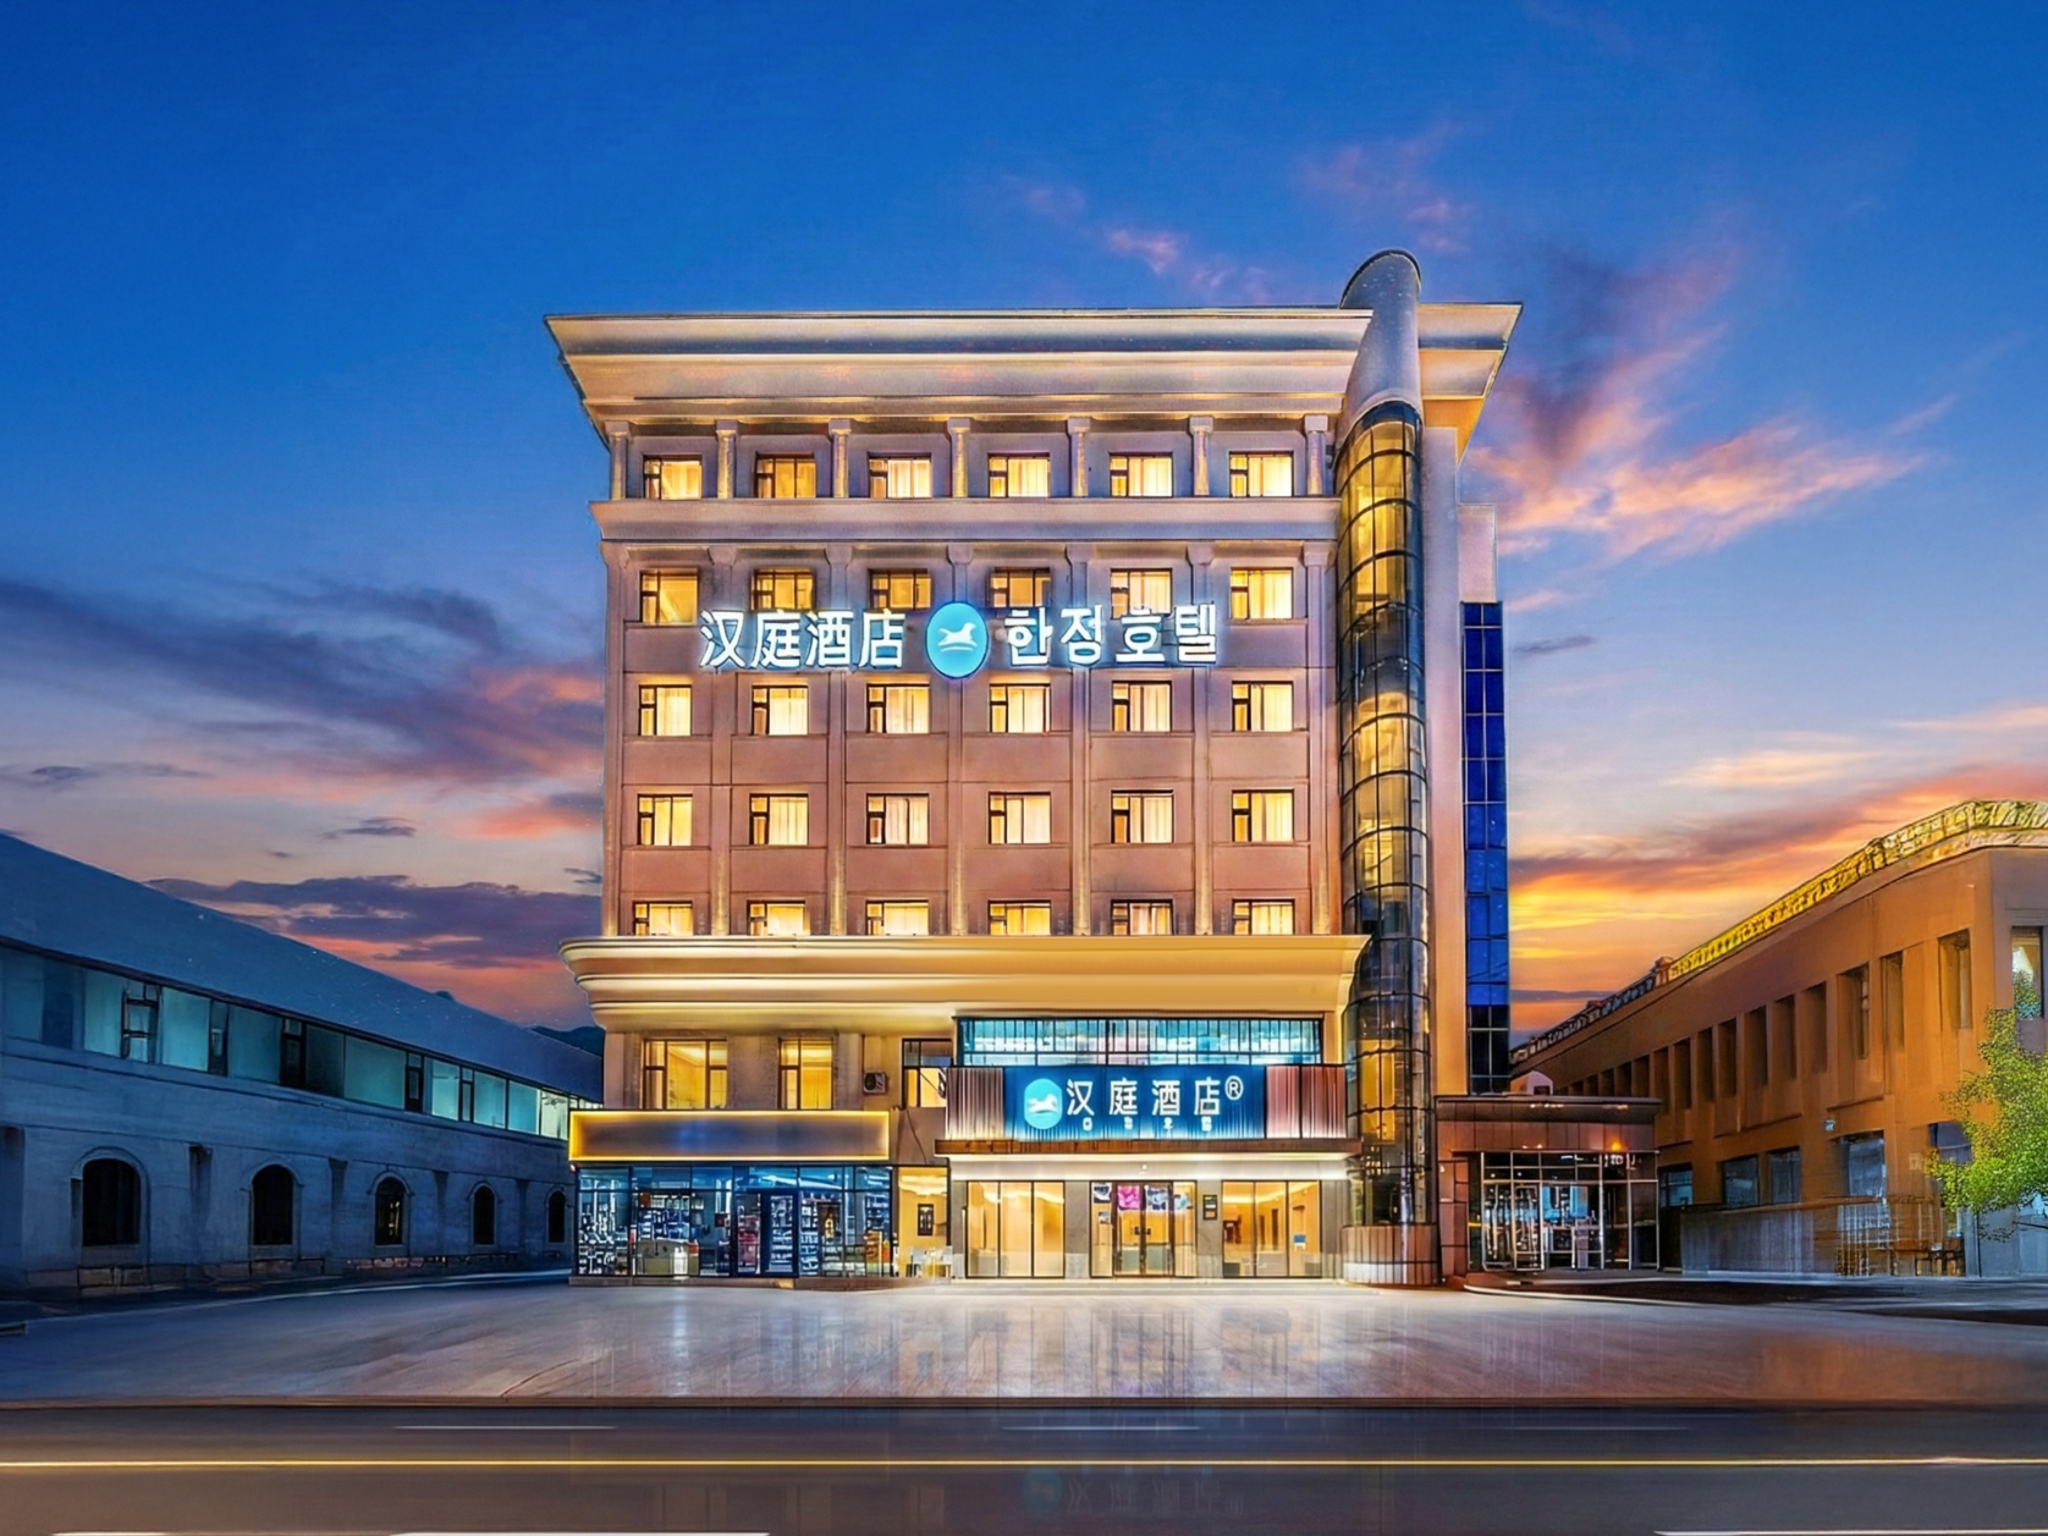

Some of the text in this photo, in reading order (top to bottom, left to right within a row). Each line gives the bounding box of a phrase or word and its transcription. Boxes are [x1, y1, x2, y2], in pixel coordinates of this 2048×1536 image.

[700, 610, 904, 667] 汉庭酒店
[1005, 605, 1218, 664] 한정호텔
